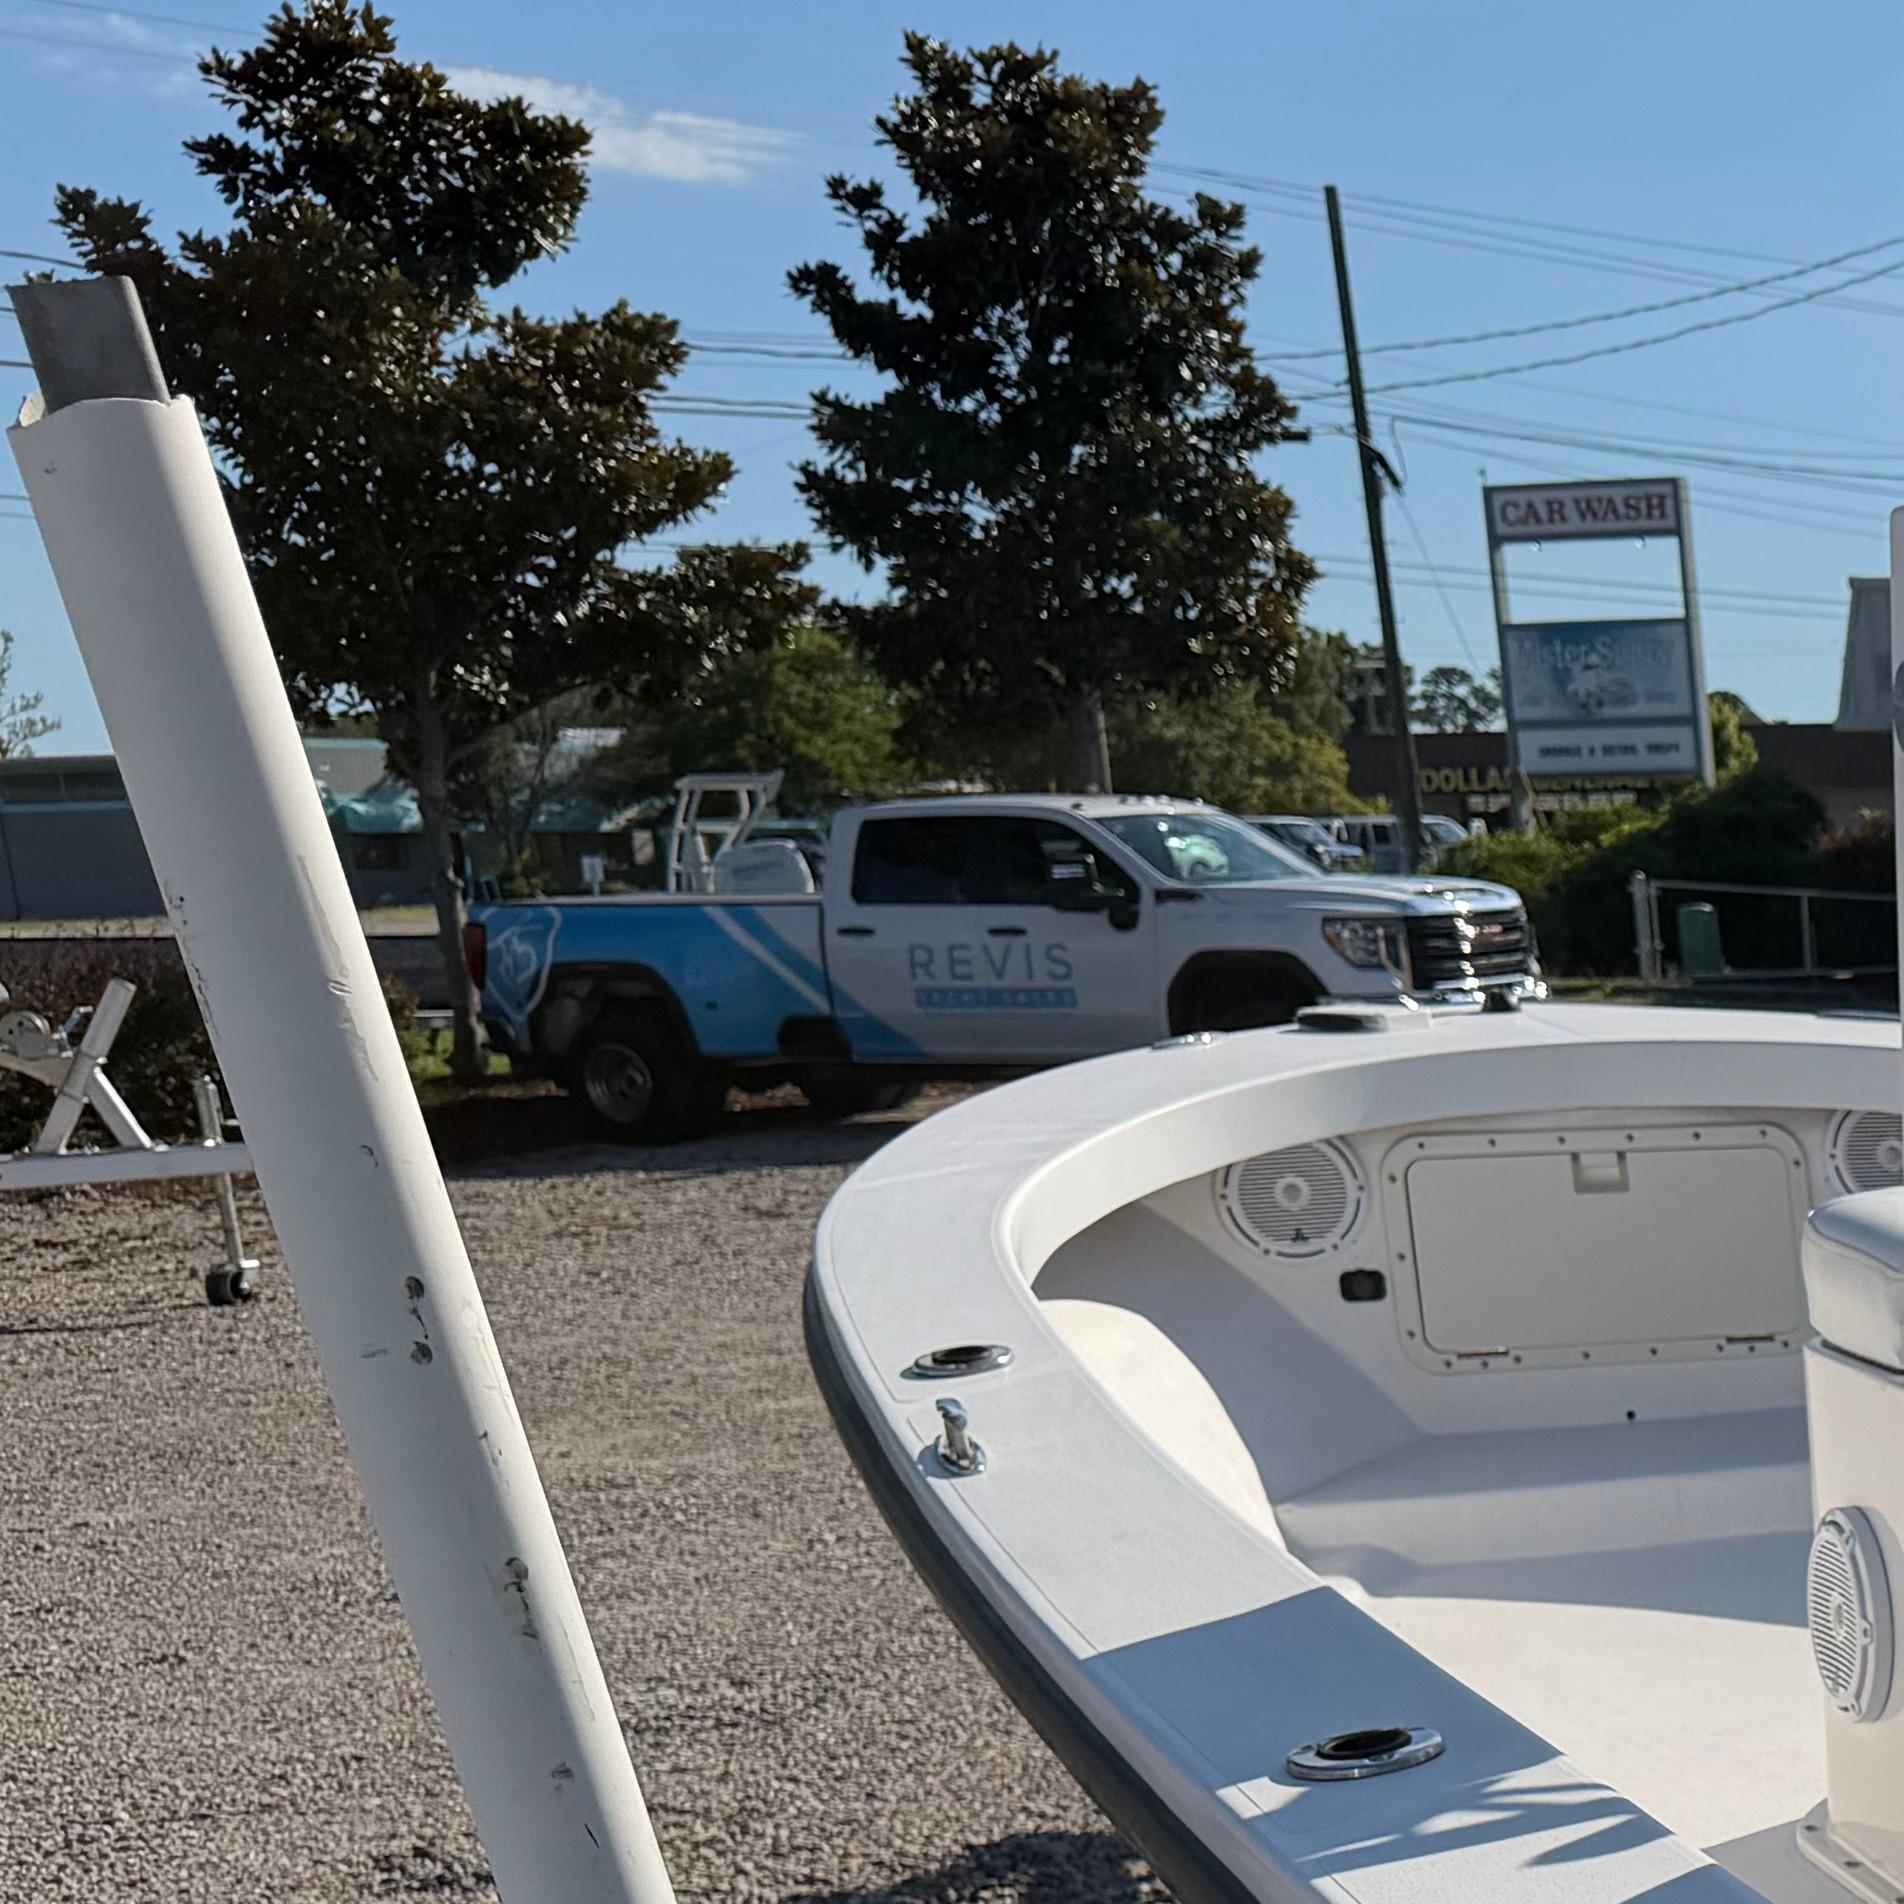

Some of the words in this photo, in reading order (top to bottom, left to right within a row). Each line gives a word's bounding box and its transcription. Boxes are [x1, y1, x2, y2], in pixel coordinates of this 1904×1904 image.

[1501, 497, 1568, 527] CAR
[1573, 493, 1668, 523] WASH
[909, 942, 1074, 981] REVIS
